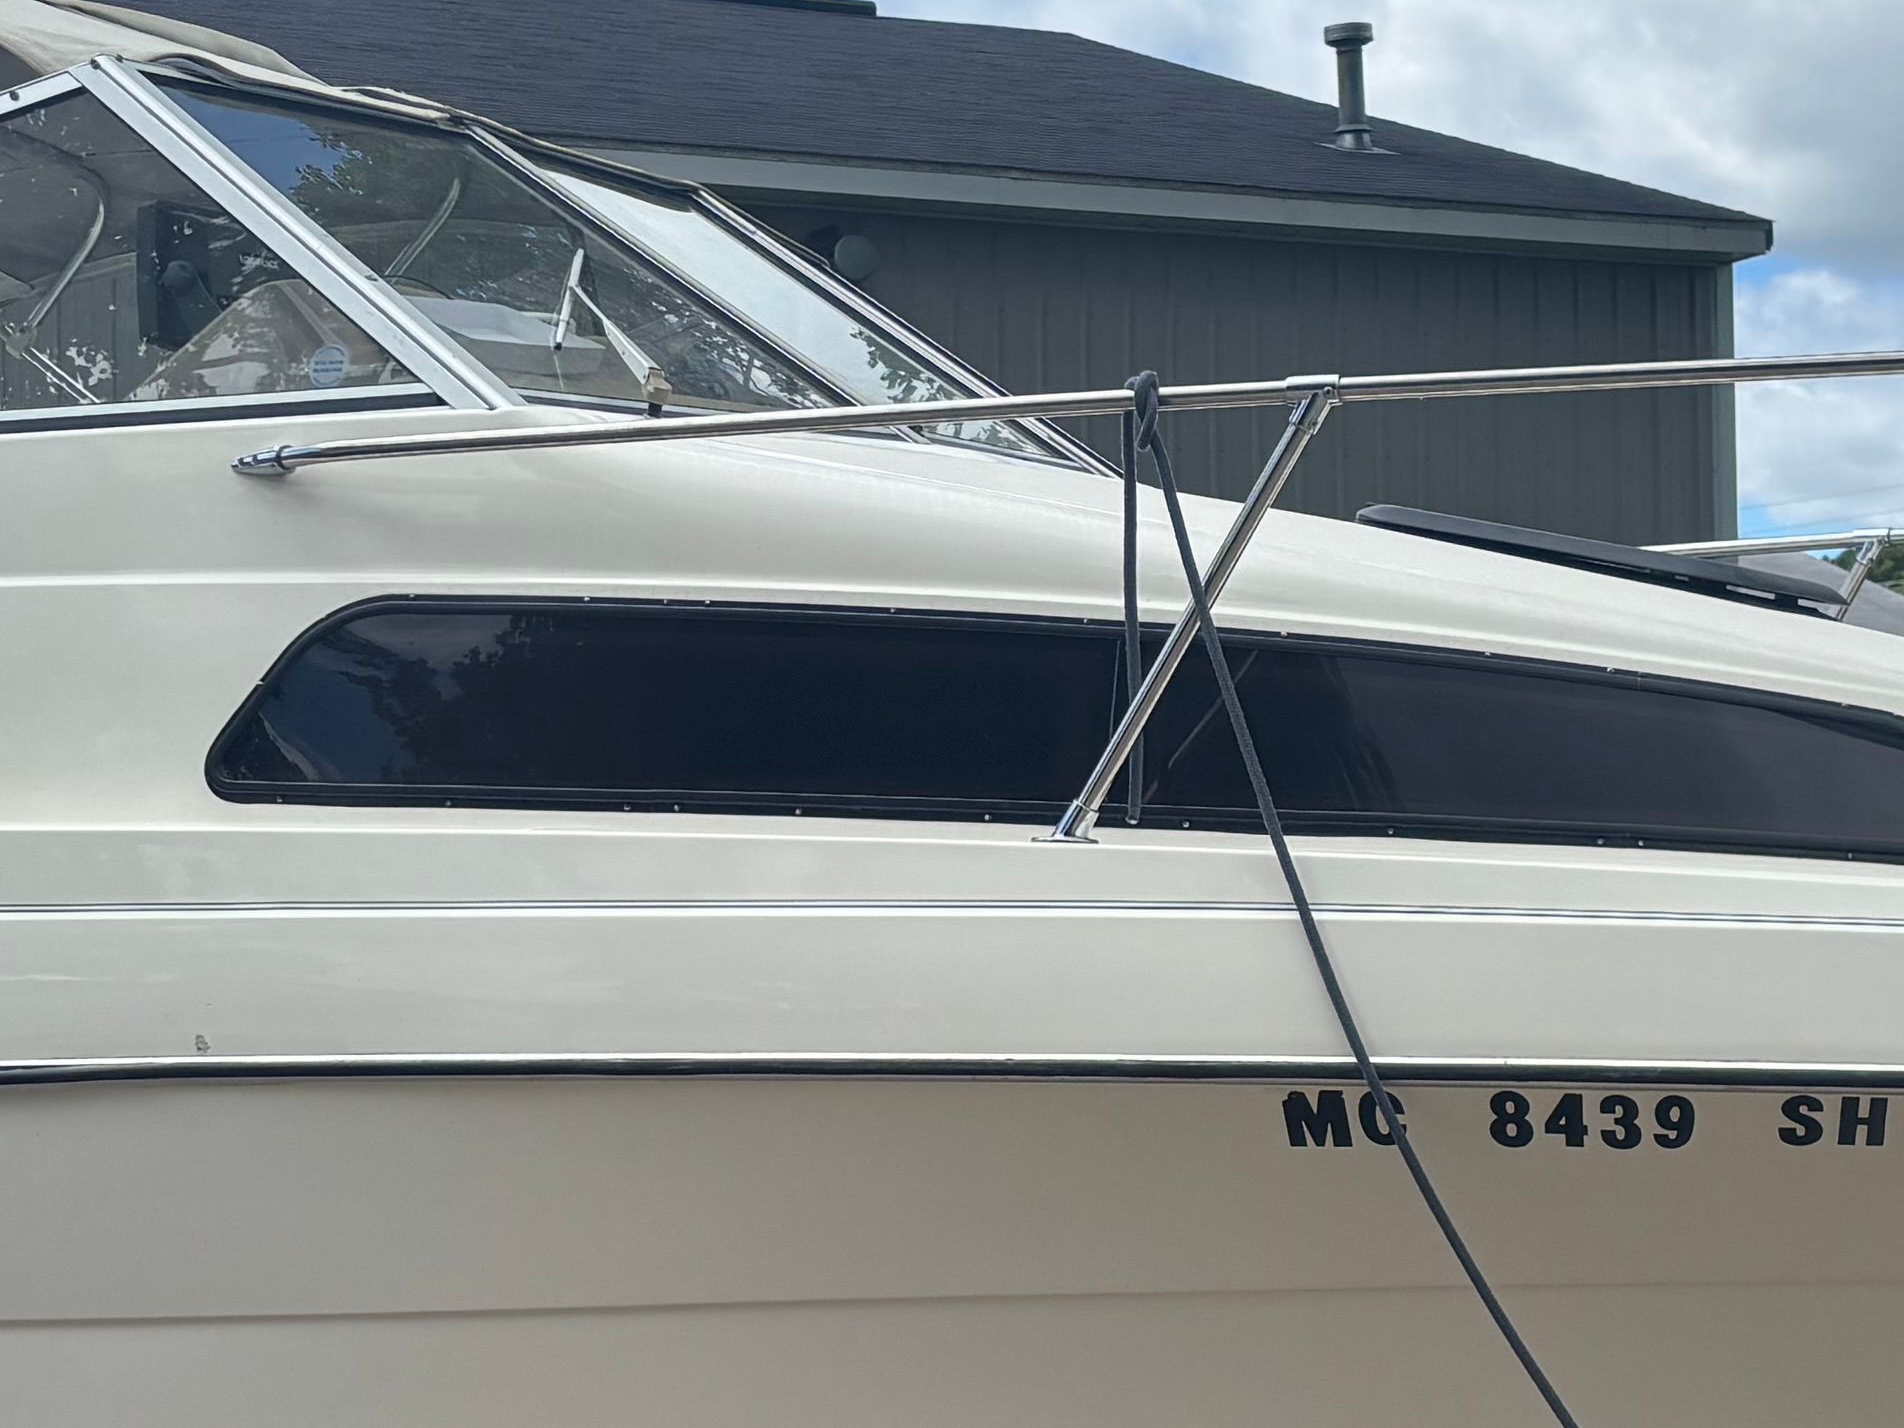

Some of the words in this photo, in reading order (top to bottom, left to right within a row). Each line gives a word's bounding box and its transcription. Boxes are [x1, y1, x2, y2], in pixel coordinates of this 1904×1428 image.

[1282, 1090, 1408, 1148] MC
[1489, 1090, 1695, 1150] 8439
[1777, 1094, 1889, 1148] SH
